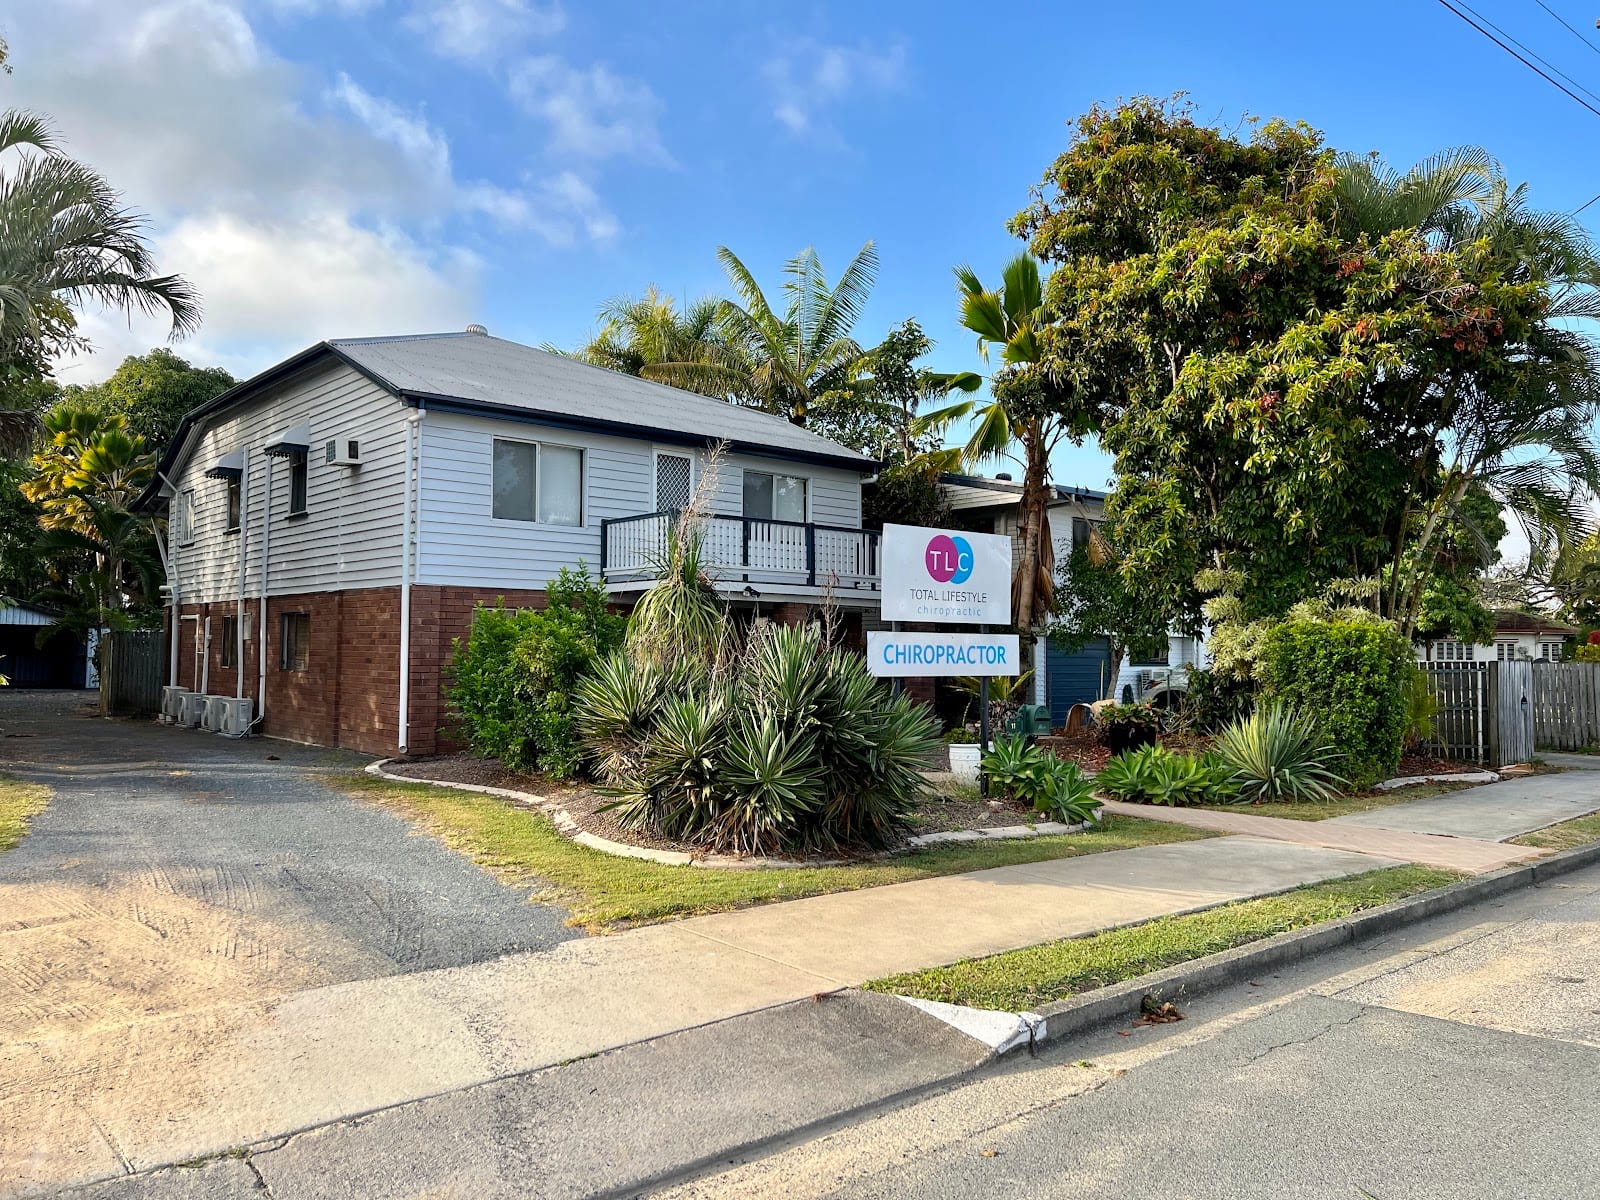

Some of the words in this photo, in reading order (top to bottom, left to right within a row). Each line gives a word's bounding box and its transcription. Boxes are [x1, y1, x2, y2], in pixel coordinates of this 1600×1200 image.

[930, 550, 969, 572] TLC
[910, 588, 939, 601] TOTAL
[942, 590, 988, 603] LIFESTYLE
[917, 605, 981, 617] chiropractic
[883, 644, 1007, 665] CHIROPRACTOR
